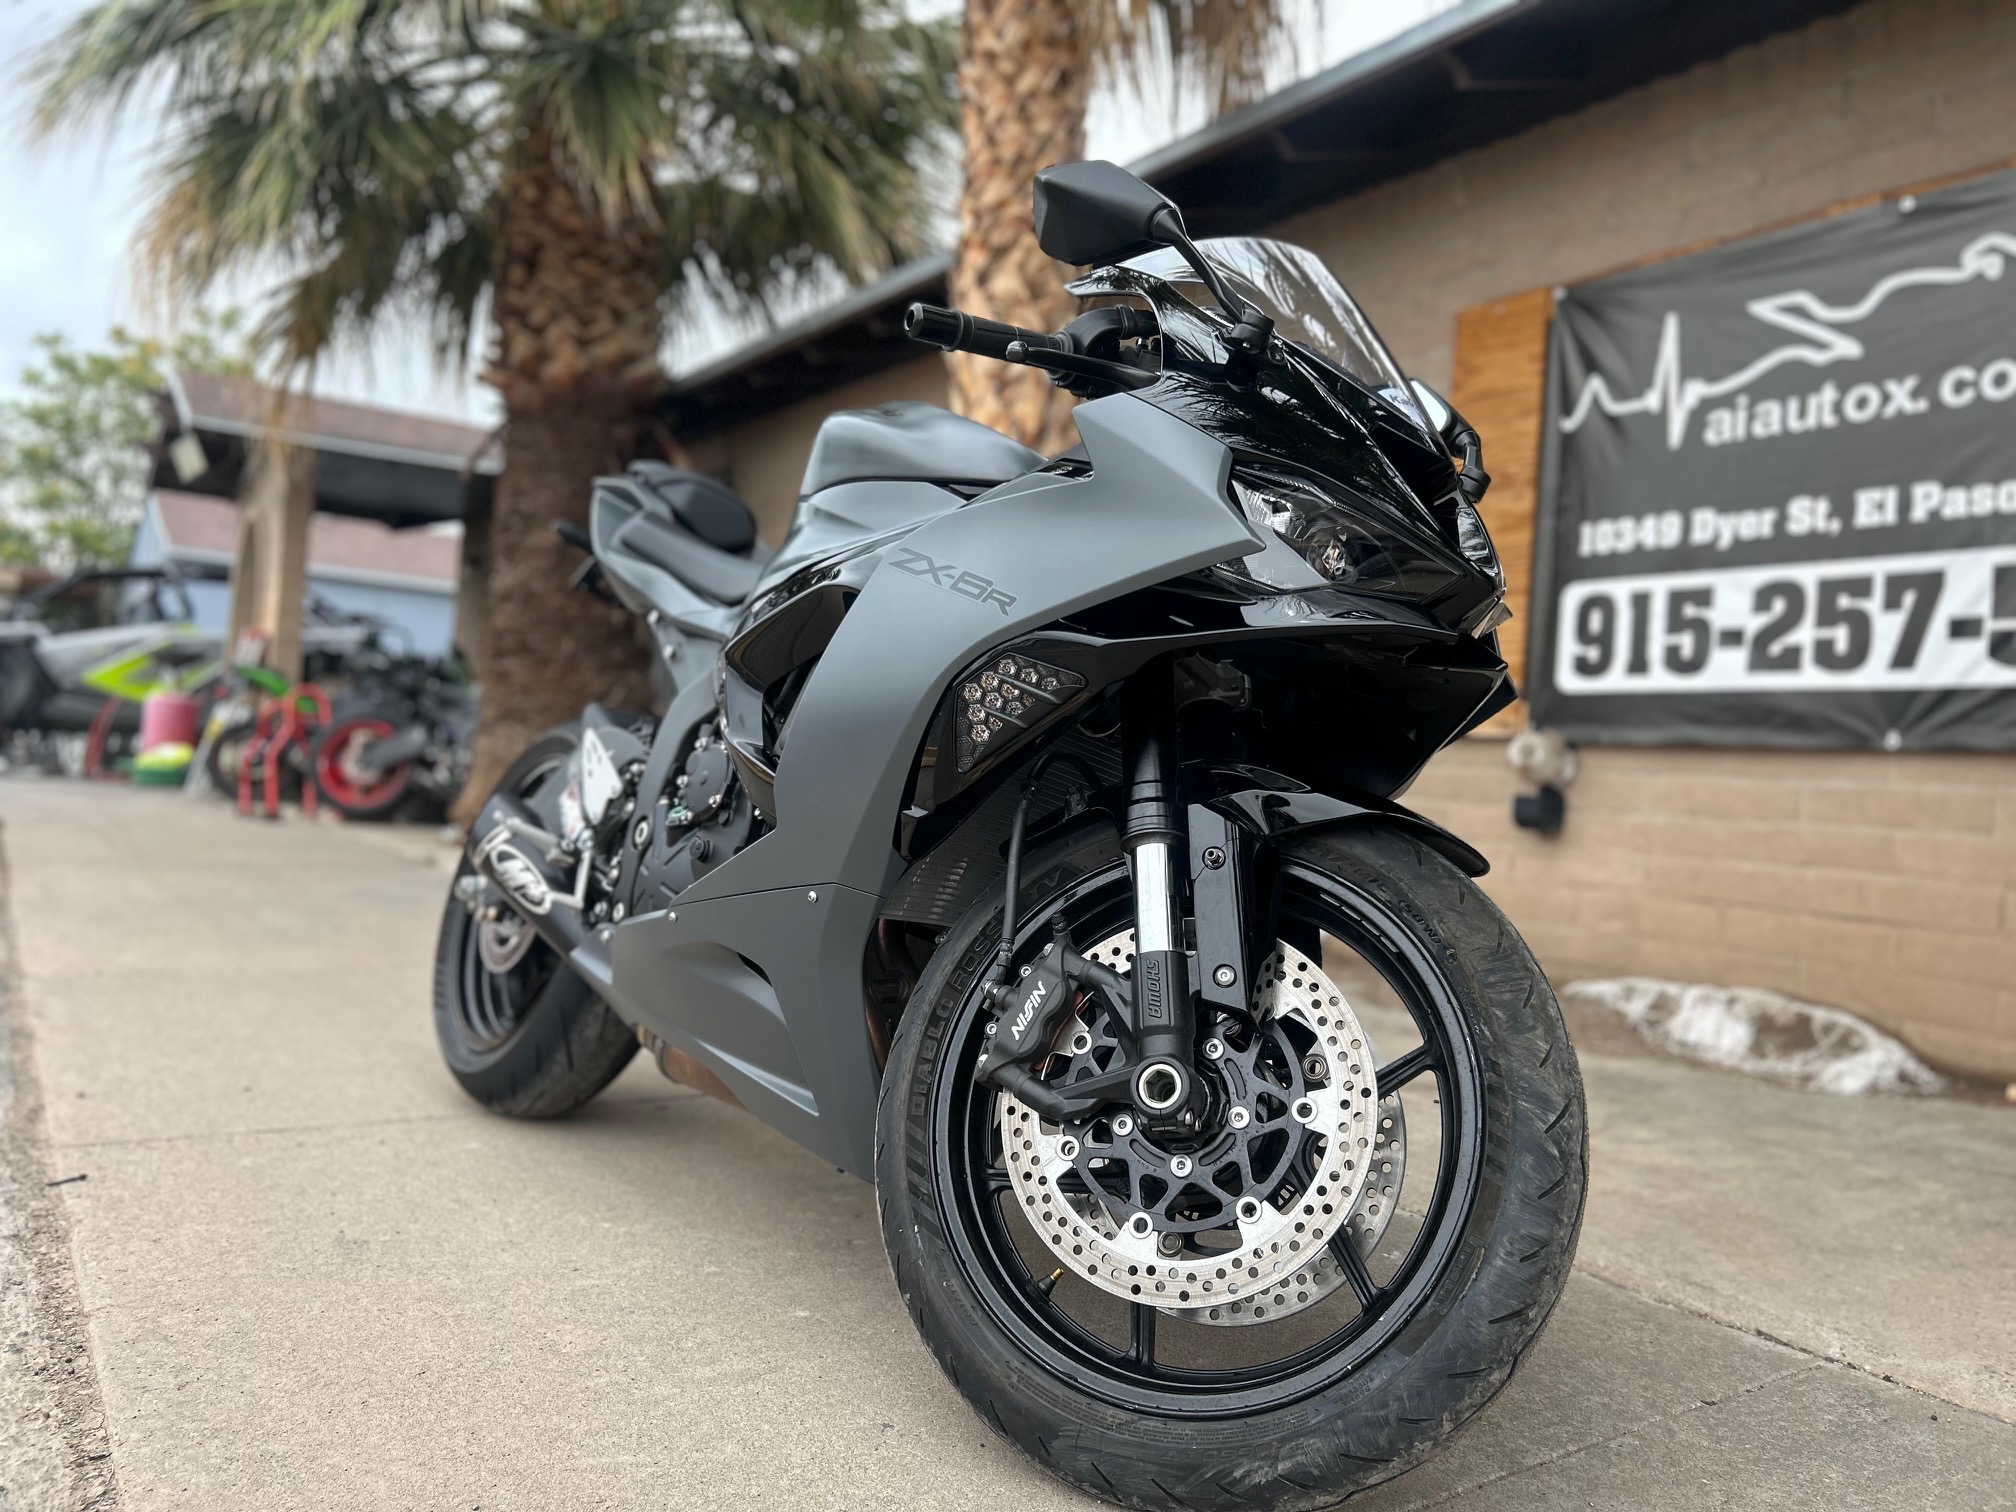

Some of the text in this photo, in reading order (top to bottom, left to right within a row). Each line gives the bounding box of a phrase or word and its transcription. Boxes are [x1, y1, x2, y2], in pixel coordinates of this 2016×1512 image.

[1578, 511, 1684, 558] 10349
[1687, 506, 1779, 551] Dyer
[1852, 484, 1899, 531] El
[888, 547, 1018, 617] ZX-6R
[951, 911, 1004, 990] ROSS
